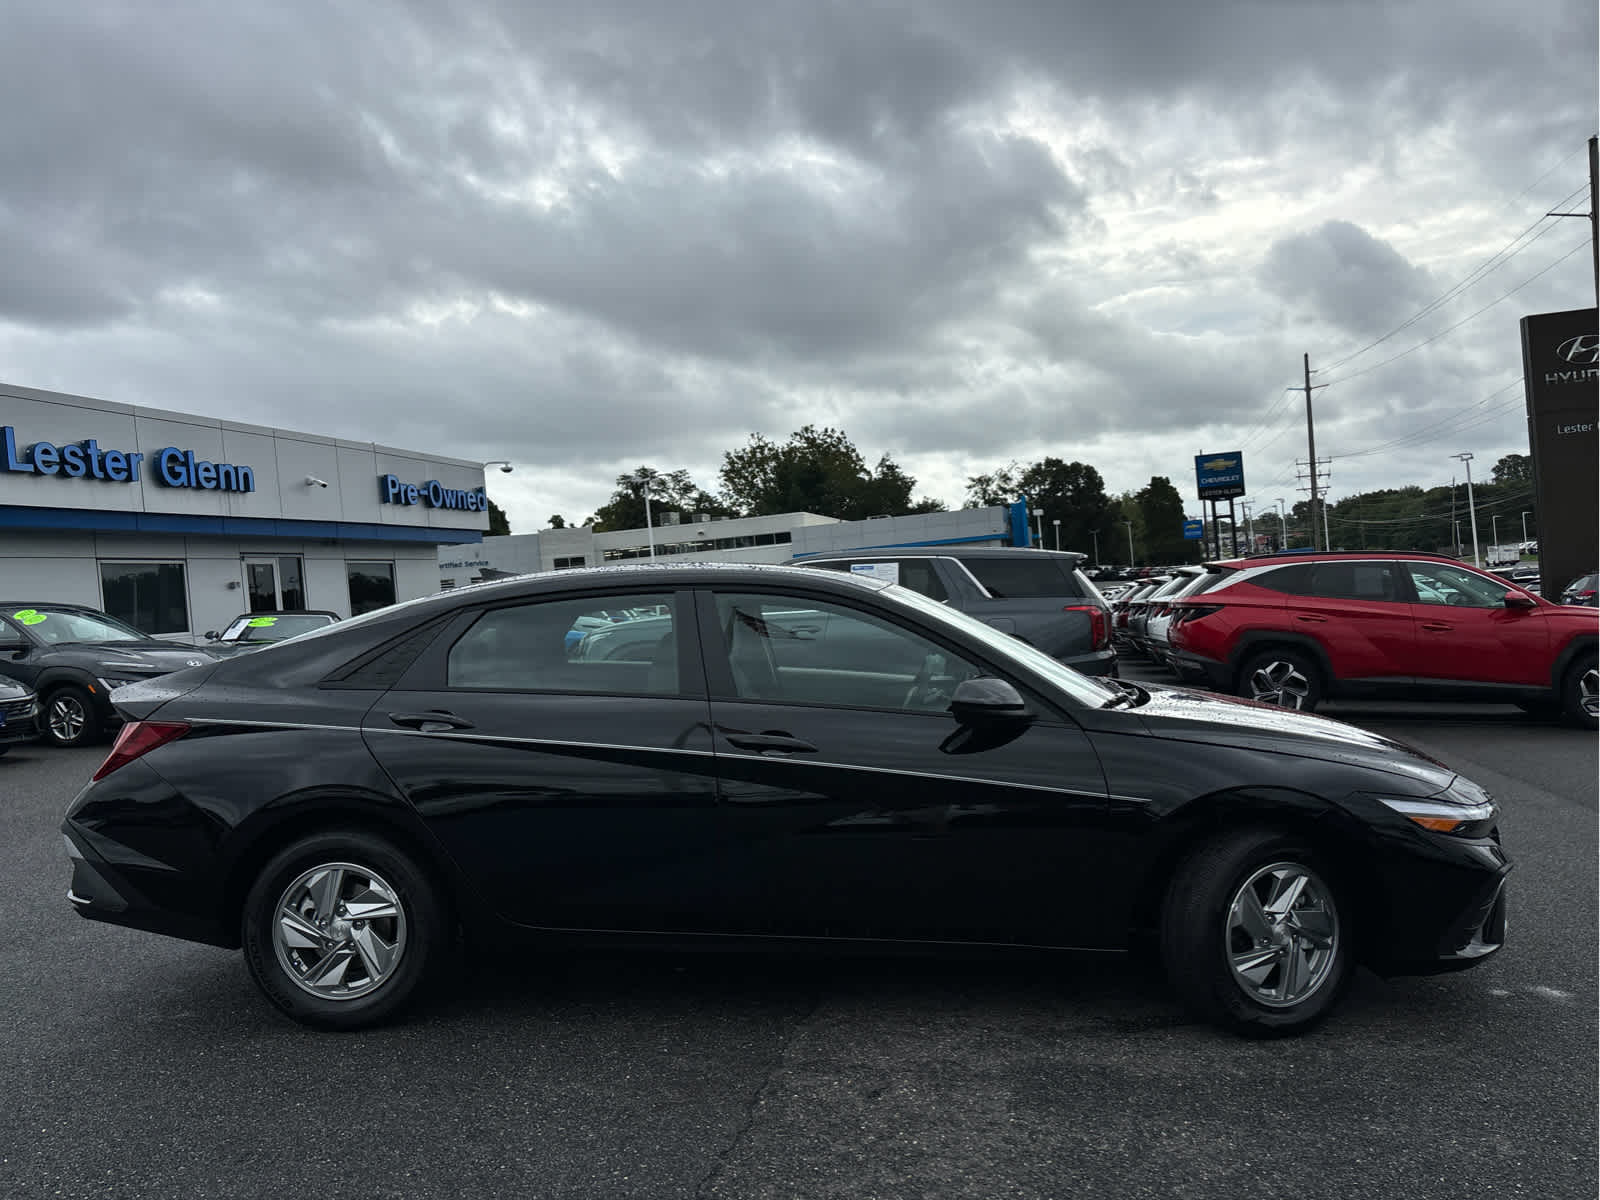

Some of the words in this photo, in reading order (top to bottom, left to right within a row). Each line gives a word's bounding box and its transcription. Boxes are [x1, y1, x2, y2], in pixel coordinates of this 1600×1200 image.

[1545, 368, 1599, 384] HYUN
[1558, 423, 1592, 434] Lester
[0, 426, 144, 482] Lester
[155, 446, 255, 492] Glenn
[382, 474, 488, 511] Pre-Owned
